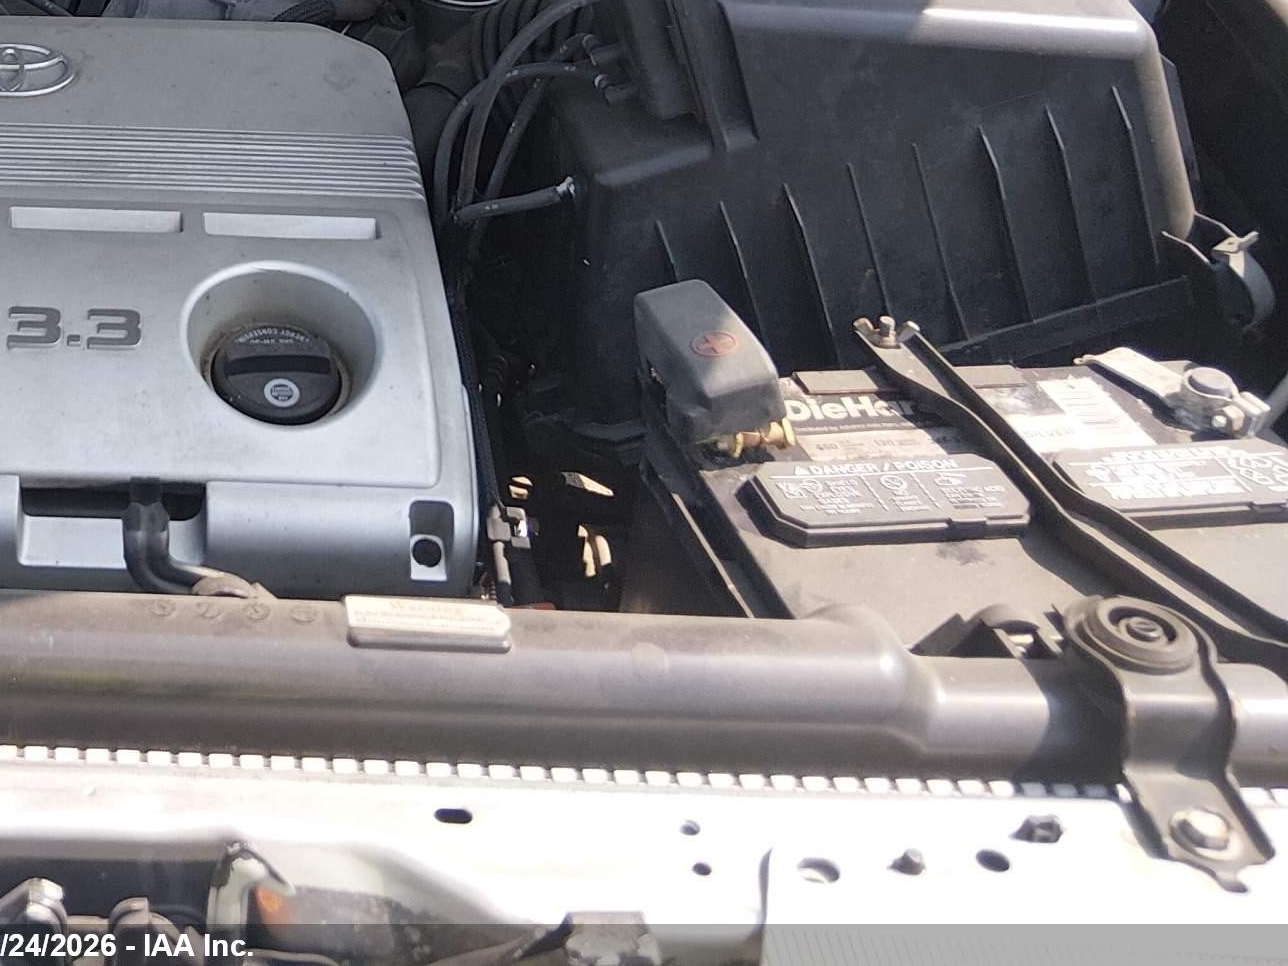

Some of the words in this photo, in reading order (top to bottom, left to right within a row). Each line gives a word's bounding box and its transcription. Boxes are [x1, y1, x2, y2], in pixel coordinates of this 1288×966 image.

[6, 305, 143, 351] 3.3
[786, 395, 914, 422] DieHar
[809, 461, 879, 475] DANGER
[893, 458, 960, 472] POISON
